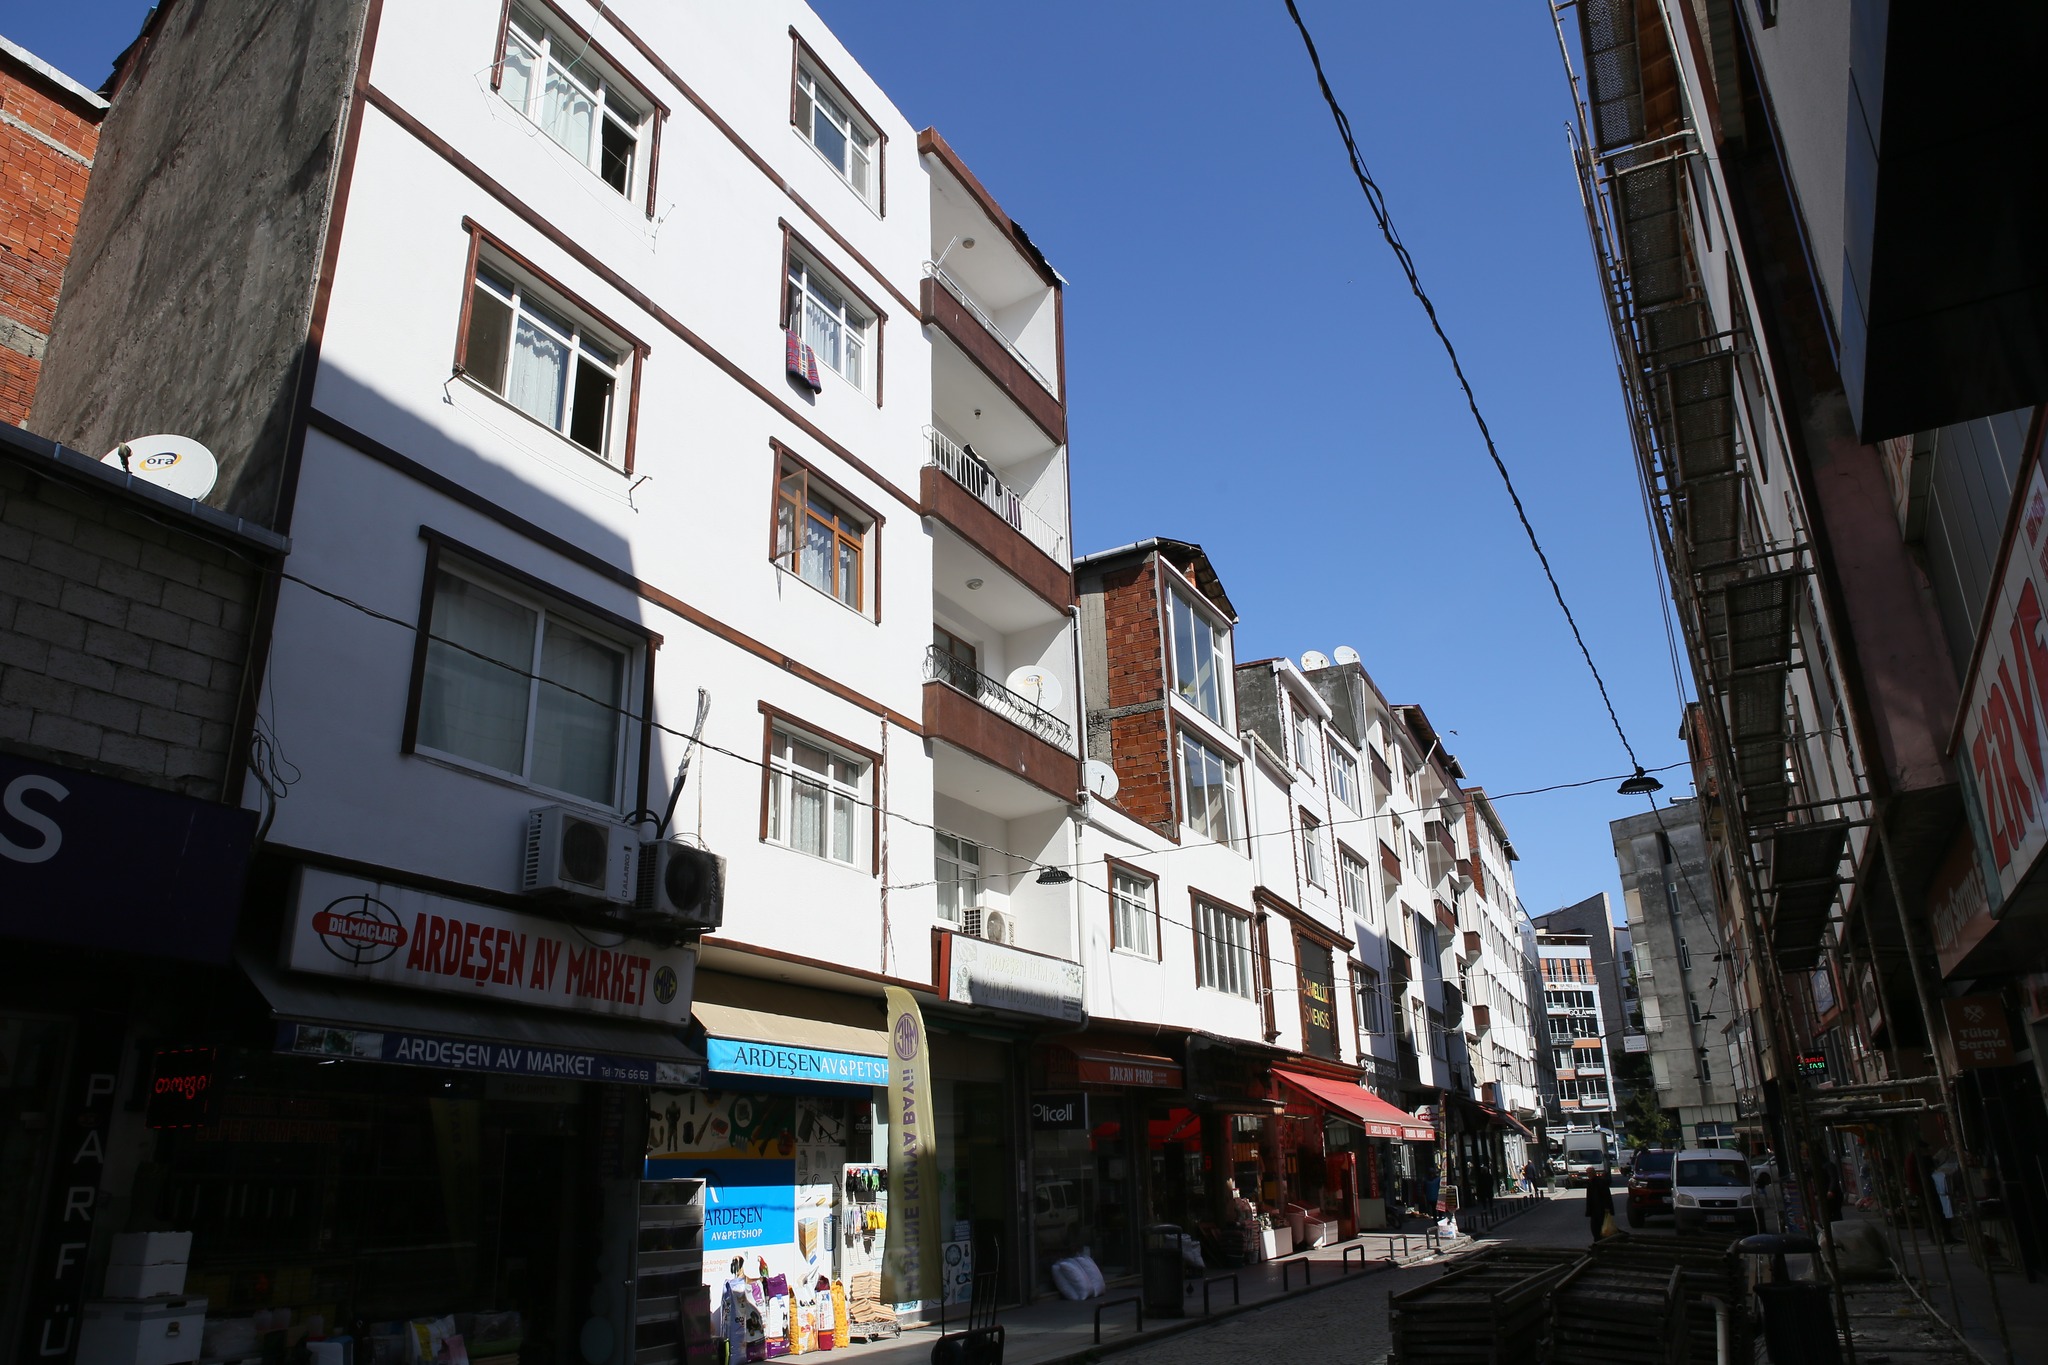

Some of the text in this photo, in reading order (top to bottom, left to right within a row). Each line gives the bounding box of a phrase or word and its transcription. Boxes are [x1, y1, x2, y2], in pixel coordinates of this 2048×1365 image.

[623, 853, 631, 890] ALARKO
[406, 912, 651, 1006] ARDEŞEN AV MARKET
[1960, 1028, 1999, 1039] Tülay
[1959, 1040, 2006, 1051] Sarma
[1974, 1048, 1996, 1060] Evi
[396, 1038, 490, 1067] ARDEŞEN
[496, 1048, 519, 1068] AV
[526, 1052, 594, 1076] MARKET
[614, 1068, 627, 1079] 715
[628, 1070, 639, 1080] 66
[639, 1071, 649, 1081] 63
[735, 1046, 820, 1076] ARDEŞEN
[1109, 1066, 1134, 1082] BAKAN
[704, 1207, 763, 1228] ARDEŞEN
[711, 1229, 762, 1241] AV&PETSHOP
